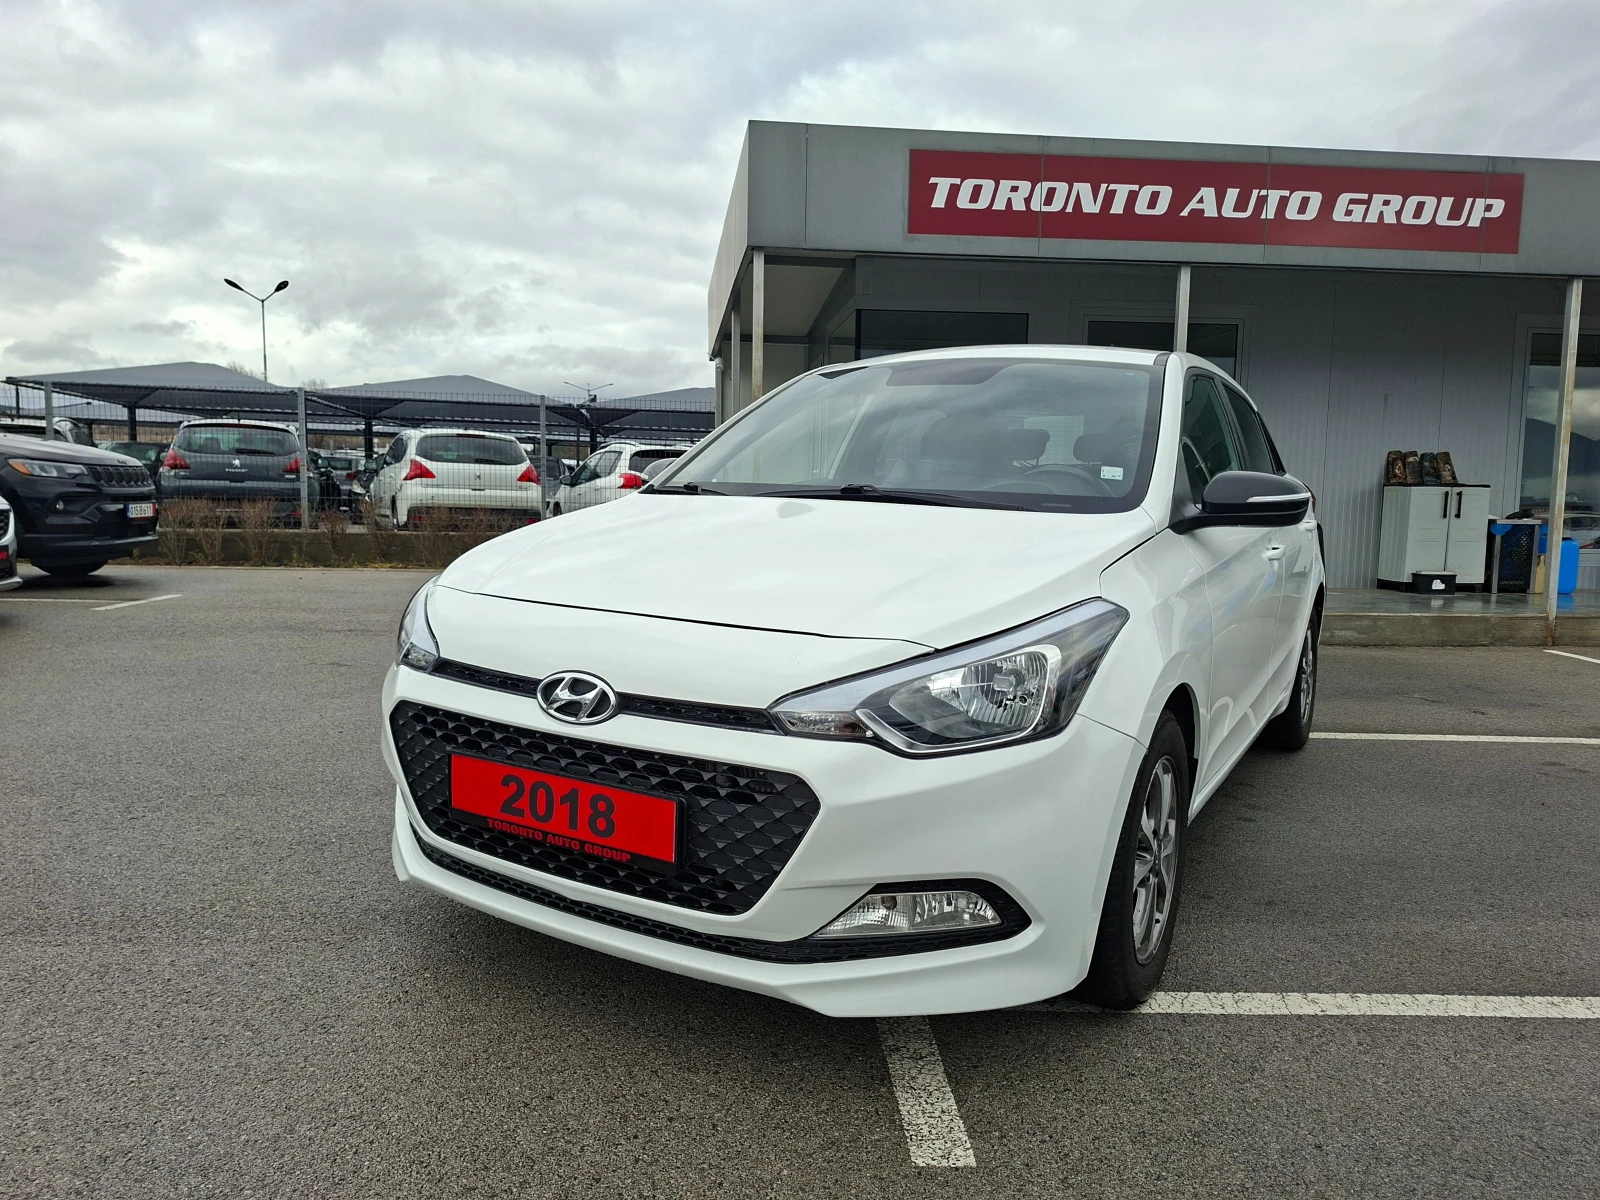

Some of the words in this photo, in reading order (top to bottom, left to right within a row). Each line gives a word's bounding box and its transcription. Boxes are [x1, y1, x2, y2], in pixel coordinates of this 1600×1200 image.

[928, 176, 1173, 216] TORONTO
[1180, 186, 1323, 221] AUTO
[1332, 192, 1506, 228] GROUP
[500, 774, 616, 839] 2018
[487, 818, 543, 841] TORONTO
[546, 834, 581, 851] AUTO
[584, 843, 631, 862] GROUP
